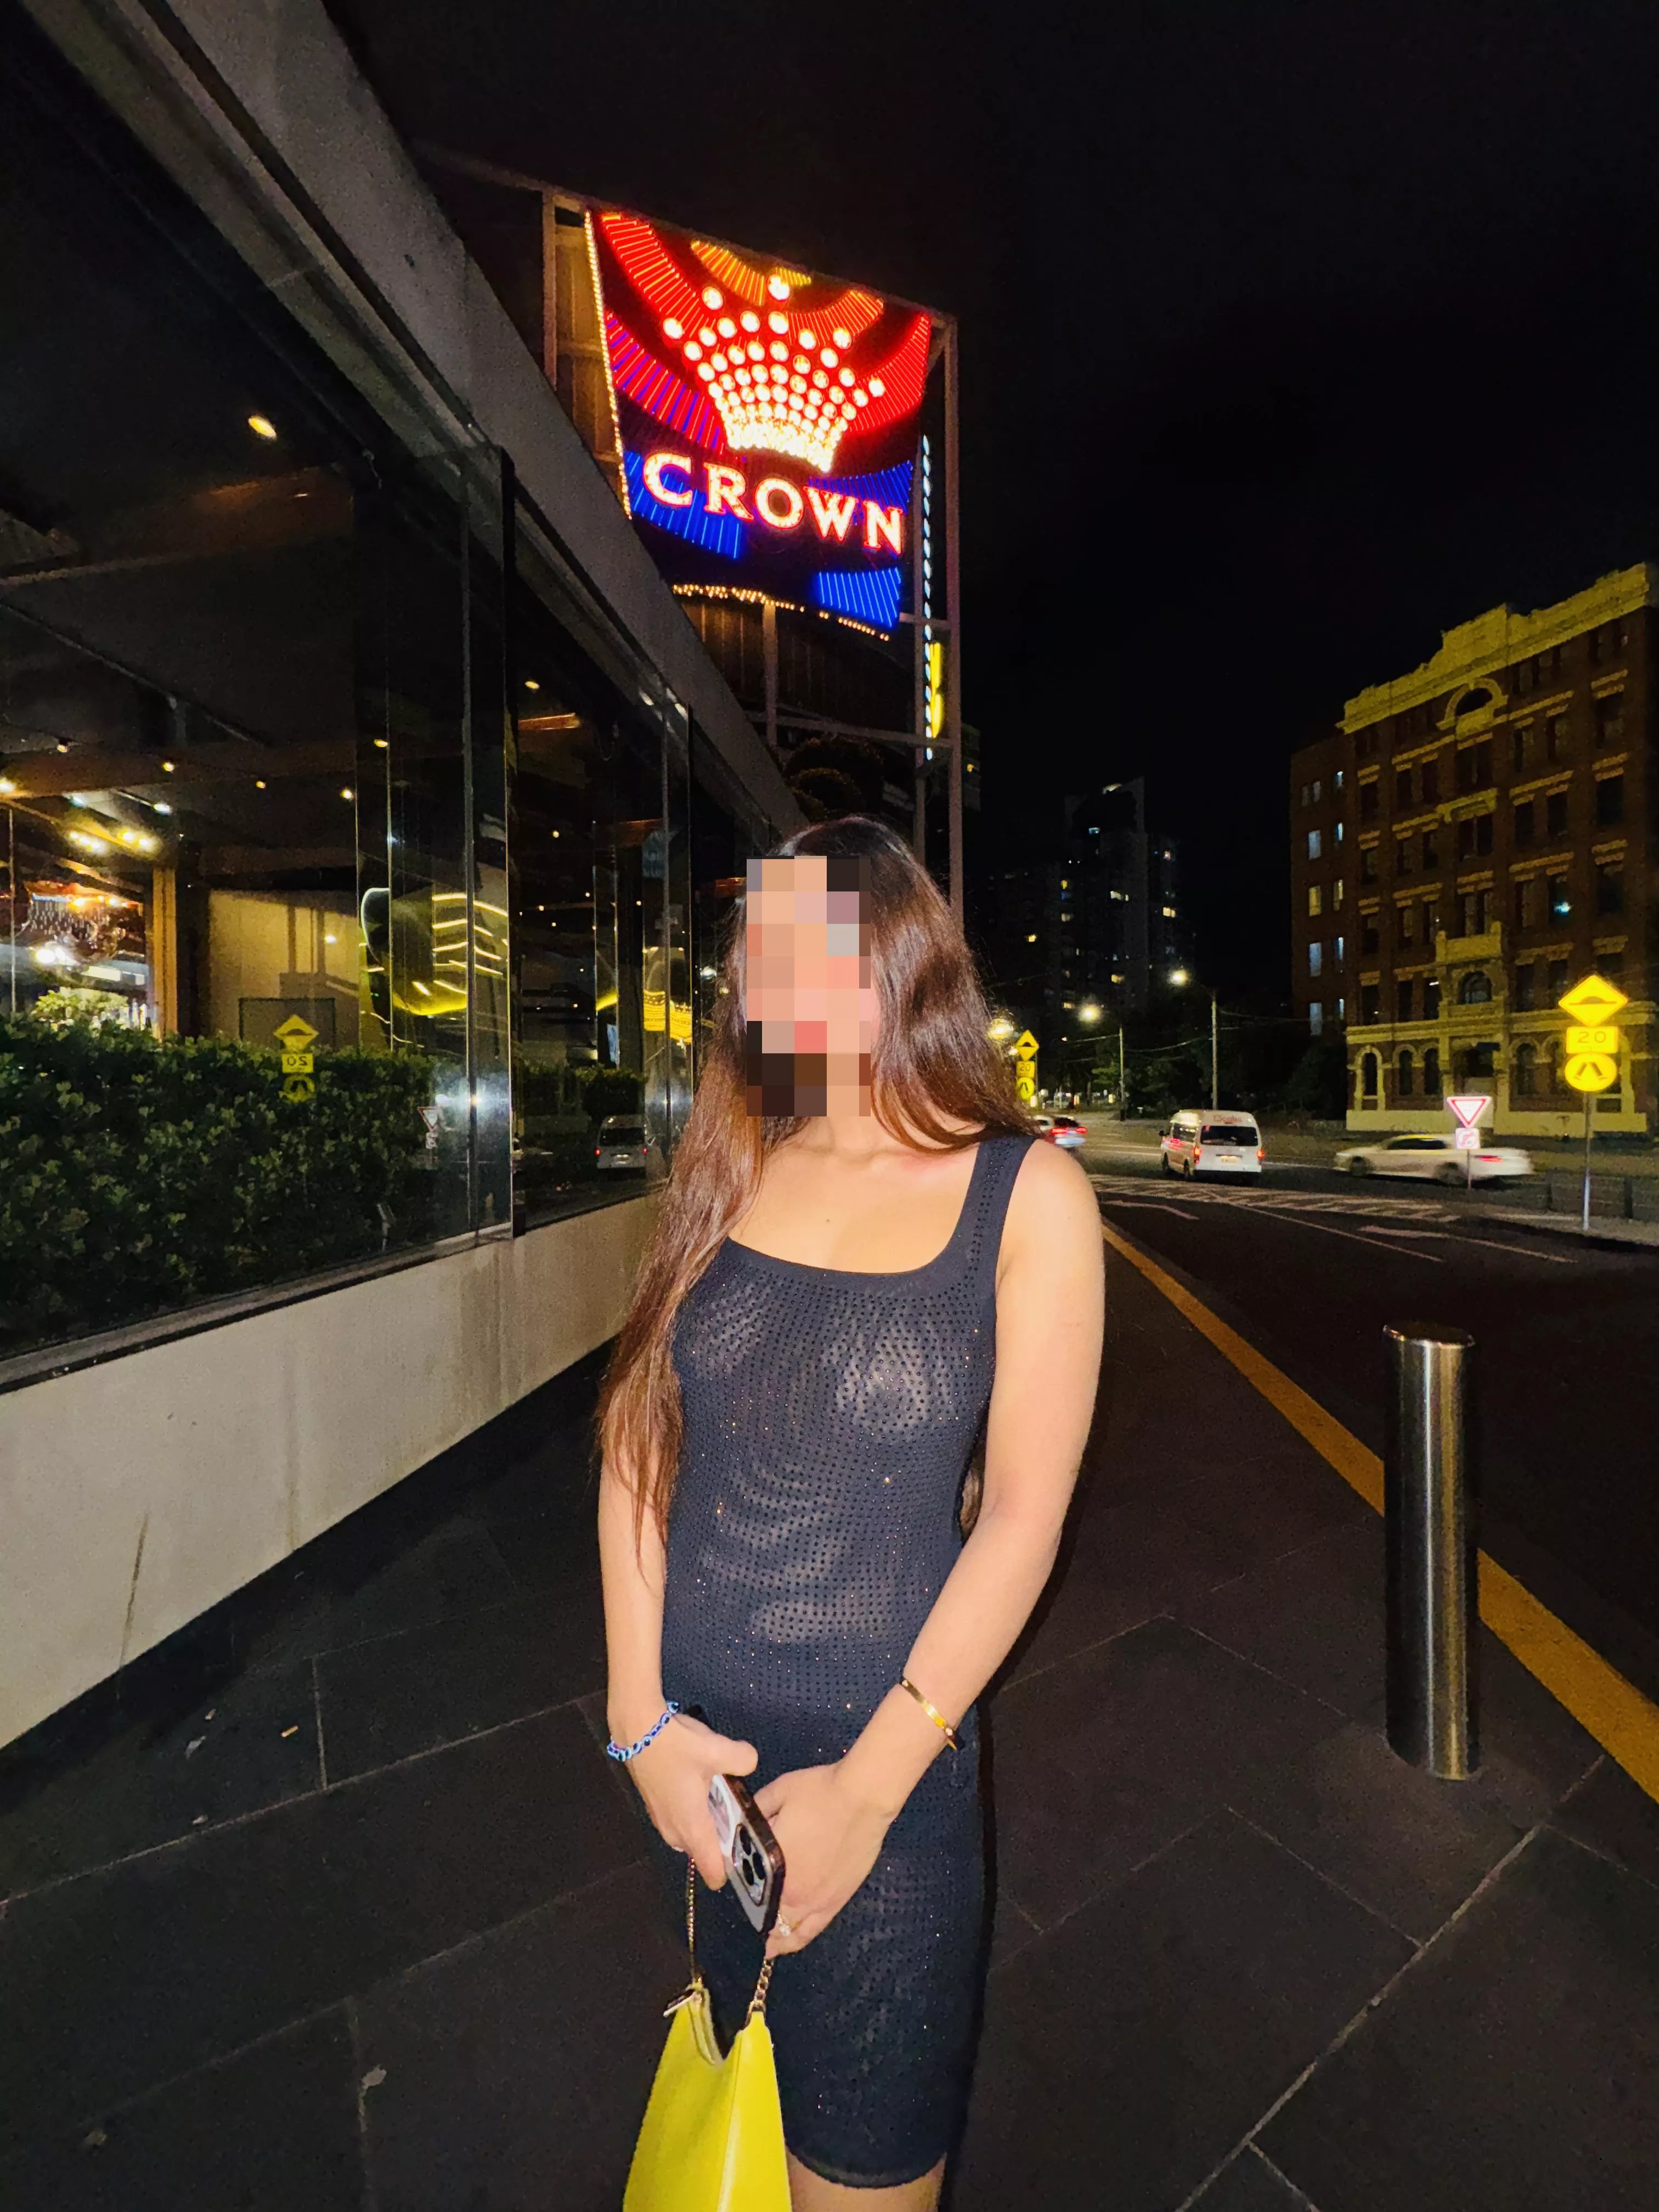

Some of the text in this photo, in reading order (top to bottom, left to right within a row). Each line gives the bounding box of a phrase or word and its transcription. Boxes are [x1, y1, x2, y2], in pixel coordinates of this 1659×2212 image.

[642, 451, 904, 555] CROWN
[1577, 1030, 1606, 1043] 20
[1020, 1063, 1031, 1071] 20
